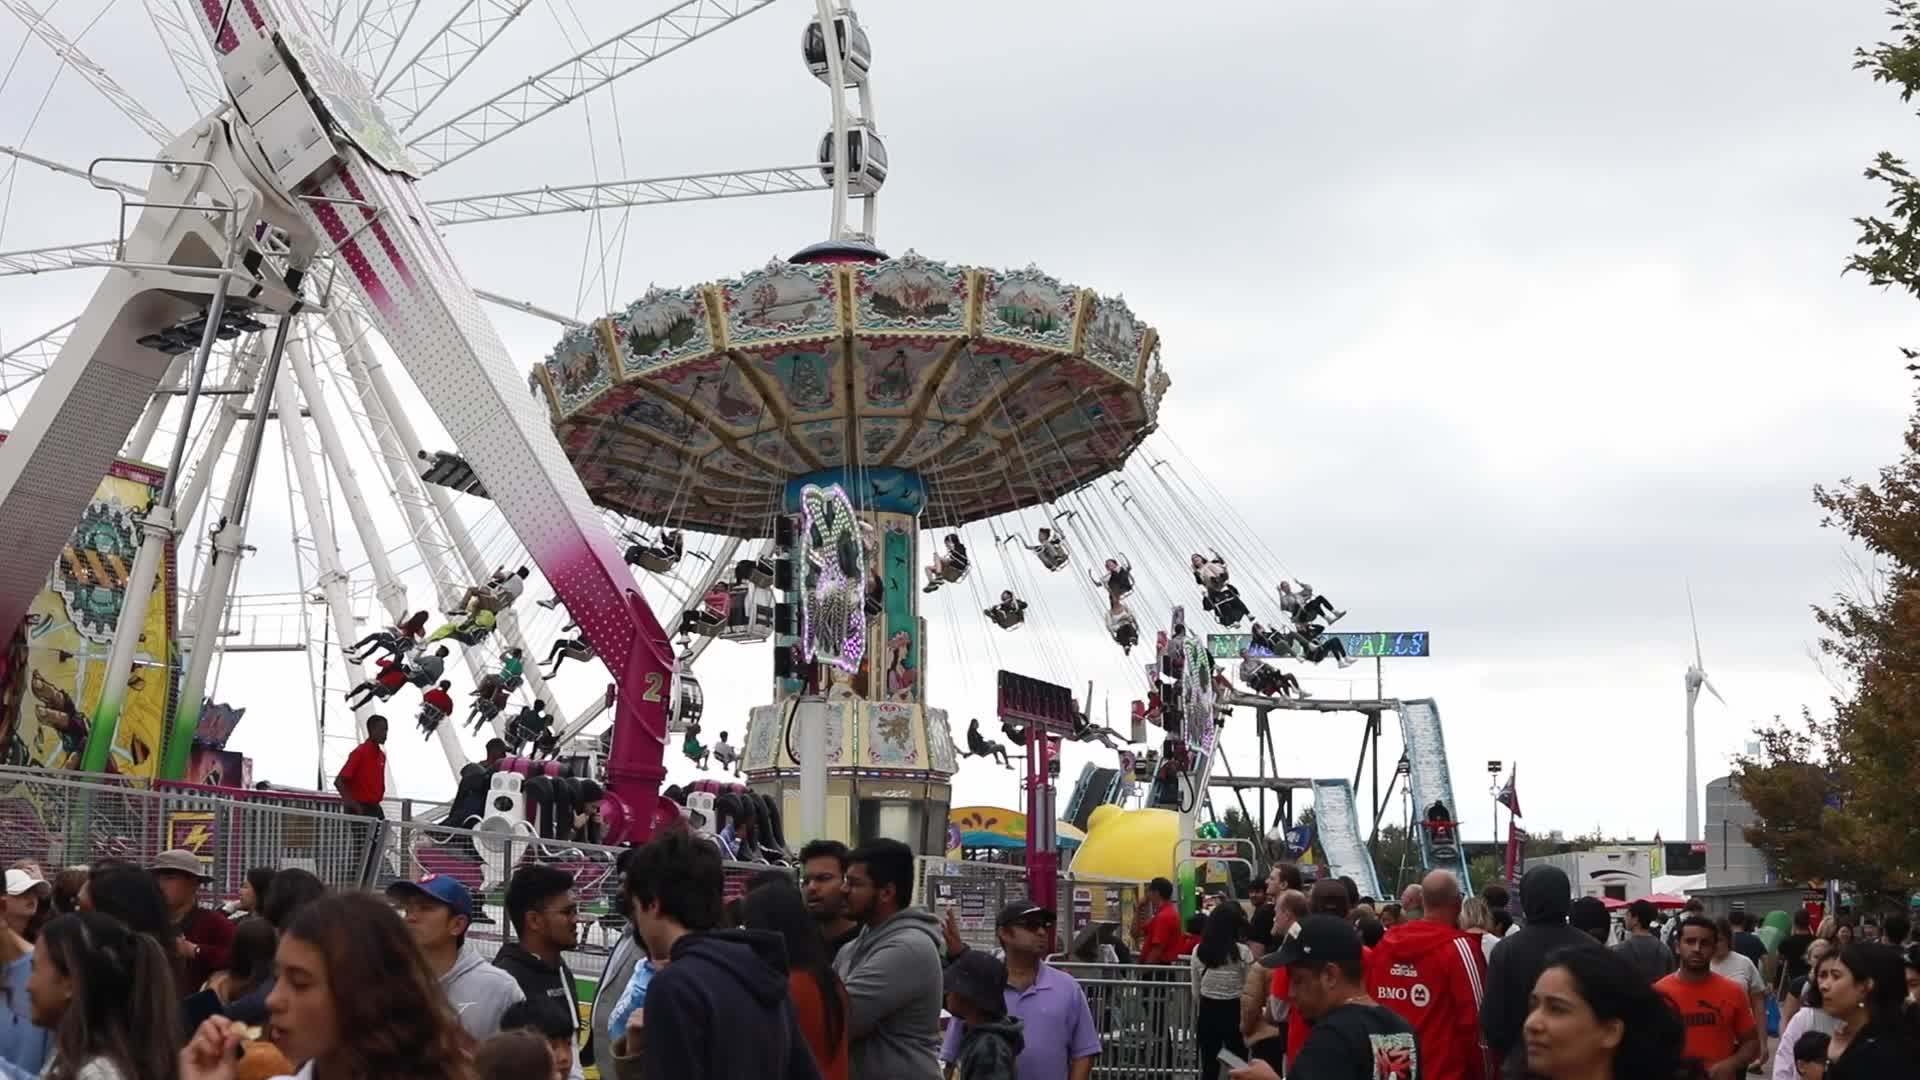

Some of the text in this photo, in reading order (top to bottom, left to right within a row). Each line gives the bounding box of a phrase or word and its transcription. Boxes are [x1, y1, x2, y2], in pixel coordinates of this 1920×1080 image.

[642, 672, 663, 702] 2
[1390, 963, 1418, 977] adidas
[1377, 986, 1407, 1000] BMO
